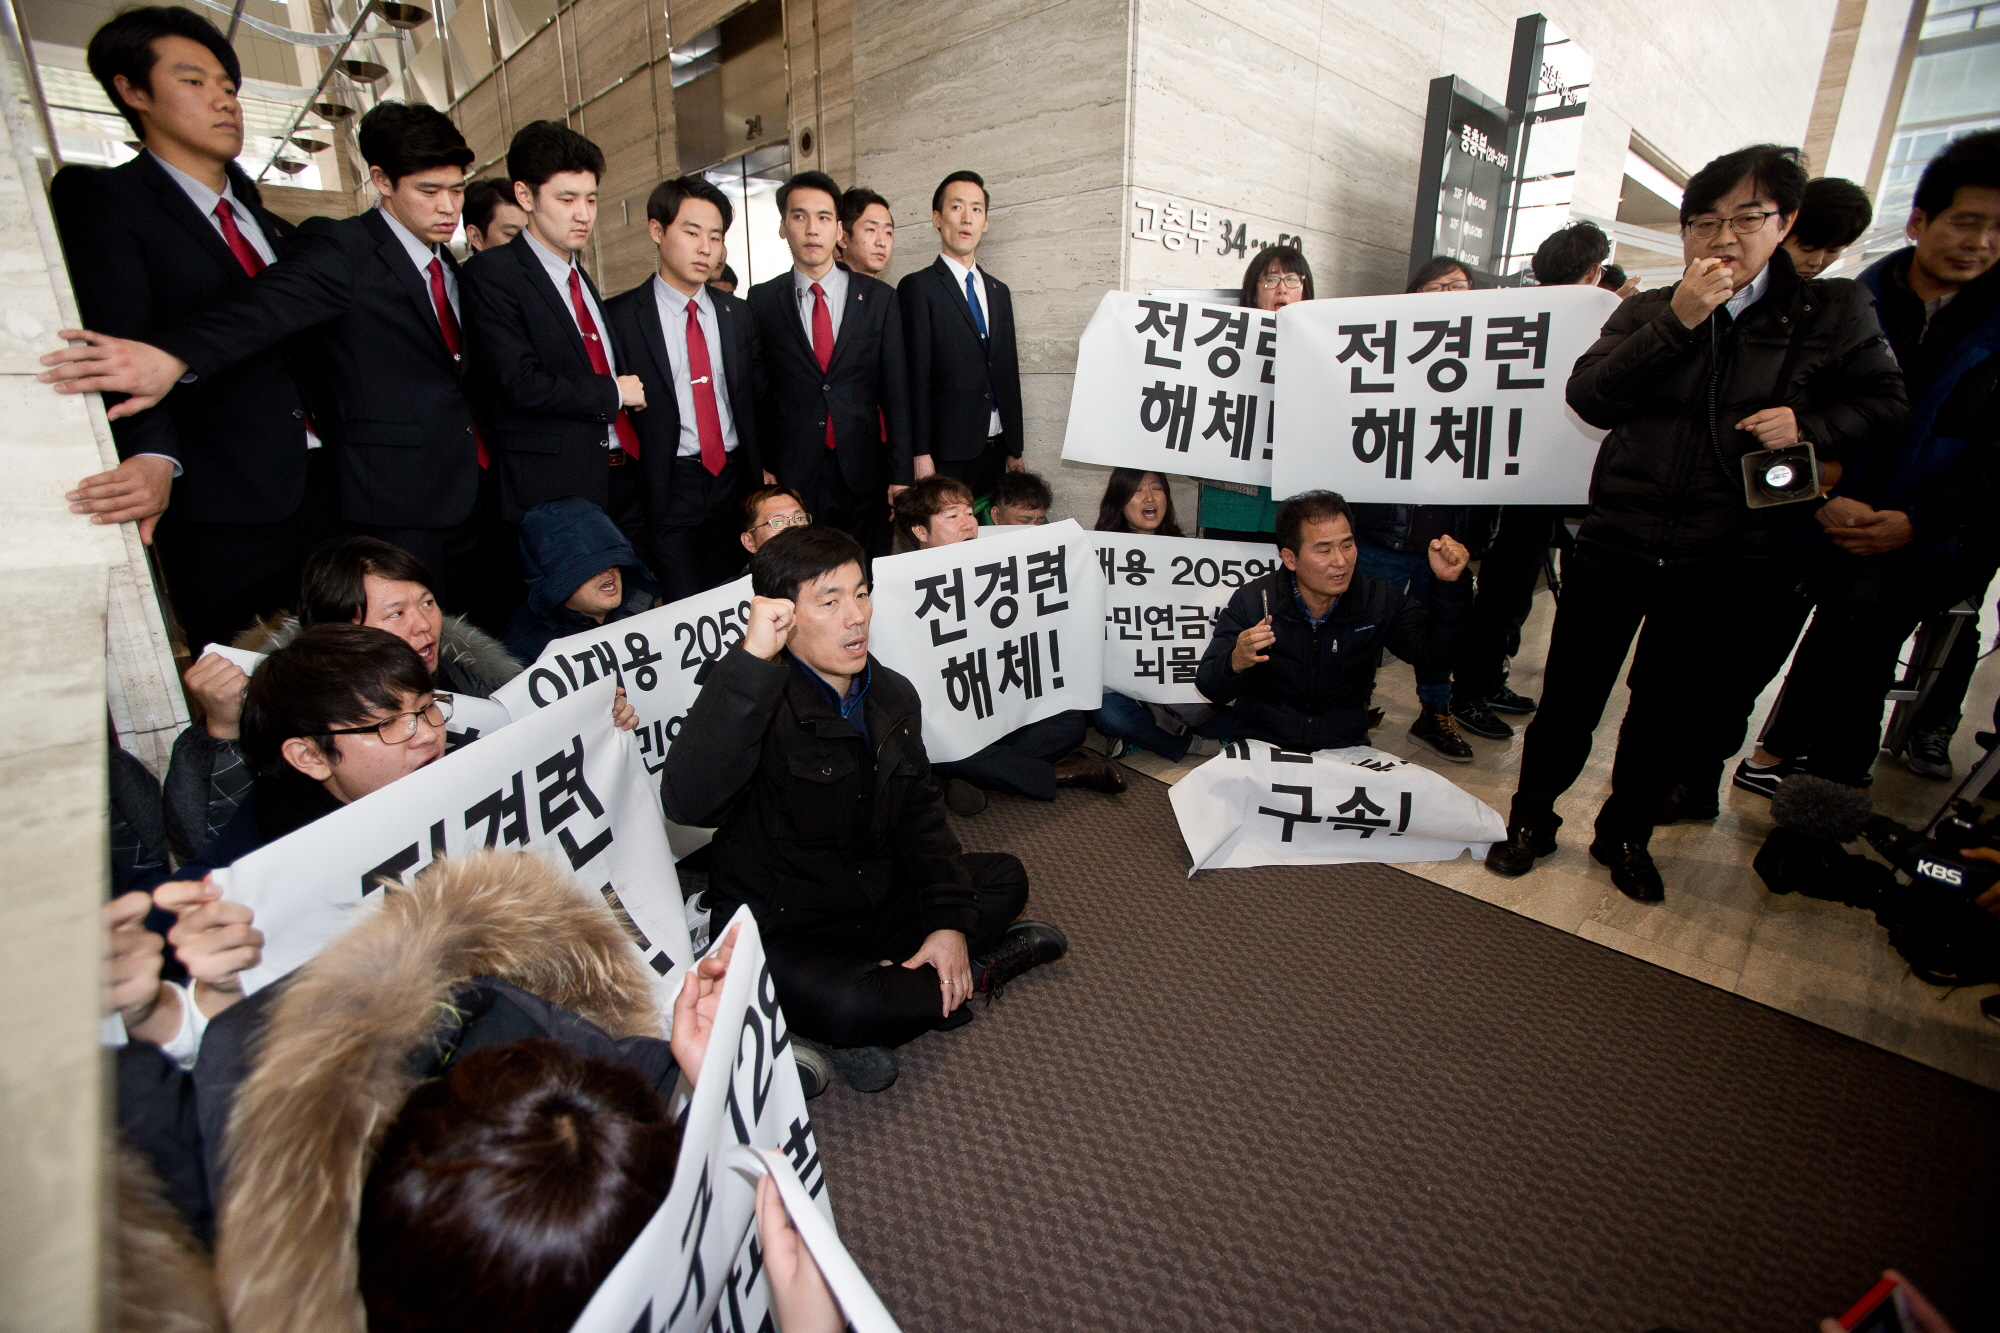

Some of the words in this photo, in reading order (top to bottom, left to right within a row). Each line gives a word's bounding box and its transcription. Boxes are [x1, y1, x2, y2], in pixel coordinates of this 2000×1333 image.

[744, 114, 763, 140] 24
[1132, 201, 1211, 254] 고층부
[1336, 311, 1552, 394] 전경련
[1351, 405, 1522, 481] 해체!
[914, 544, 1069, 647] 전경련
[941, 628, 1065, 720] 해체!
[1257, 782, 1413, 843] 구속!
[1916, 859, 1963, 886] KBS
